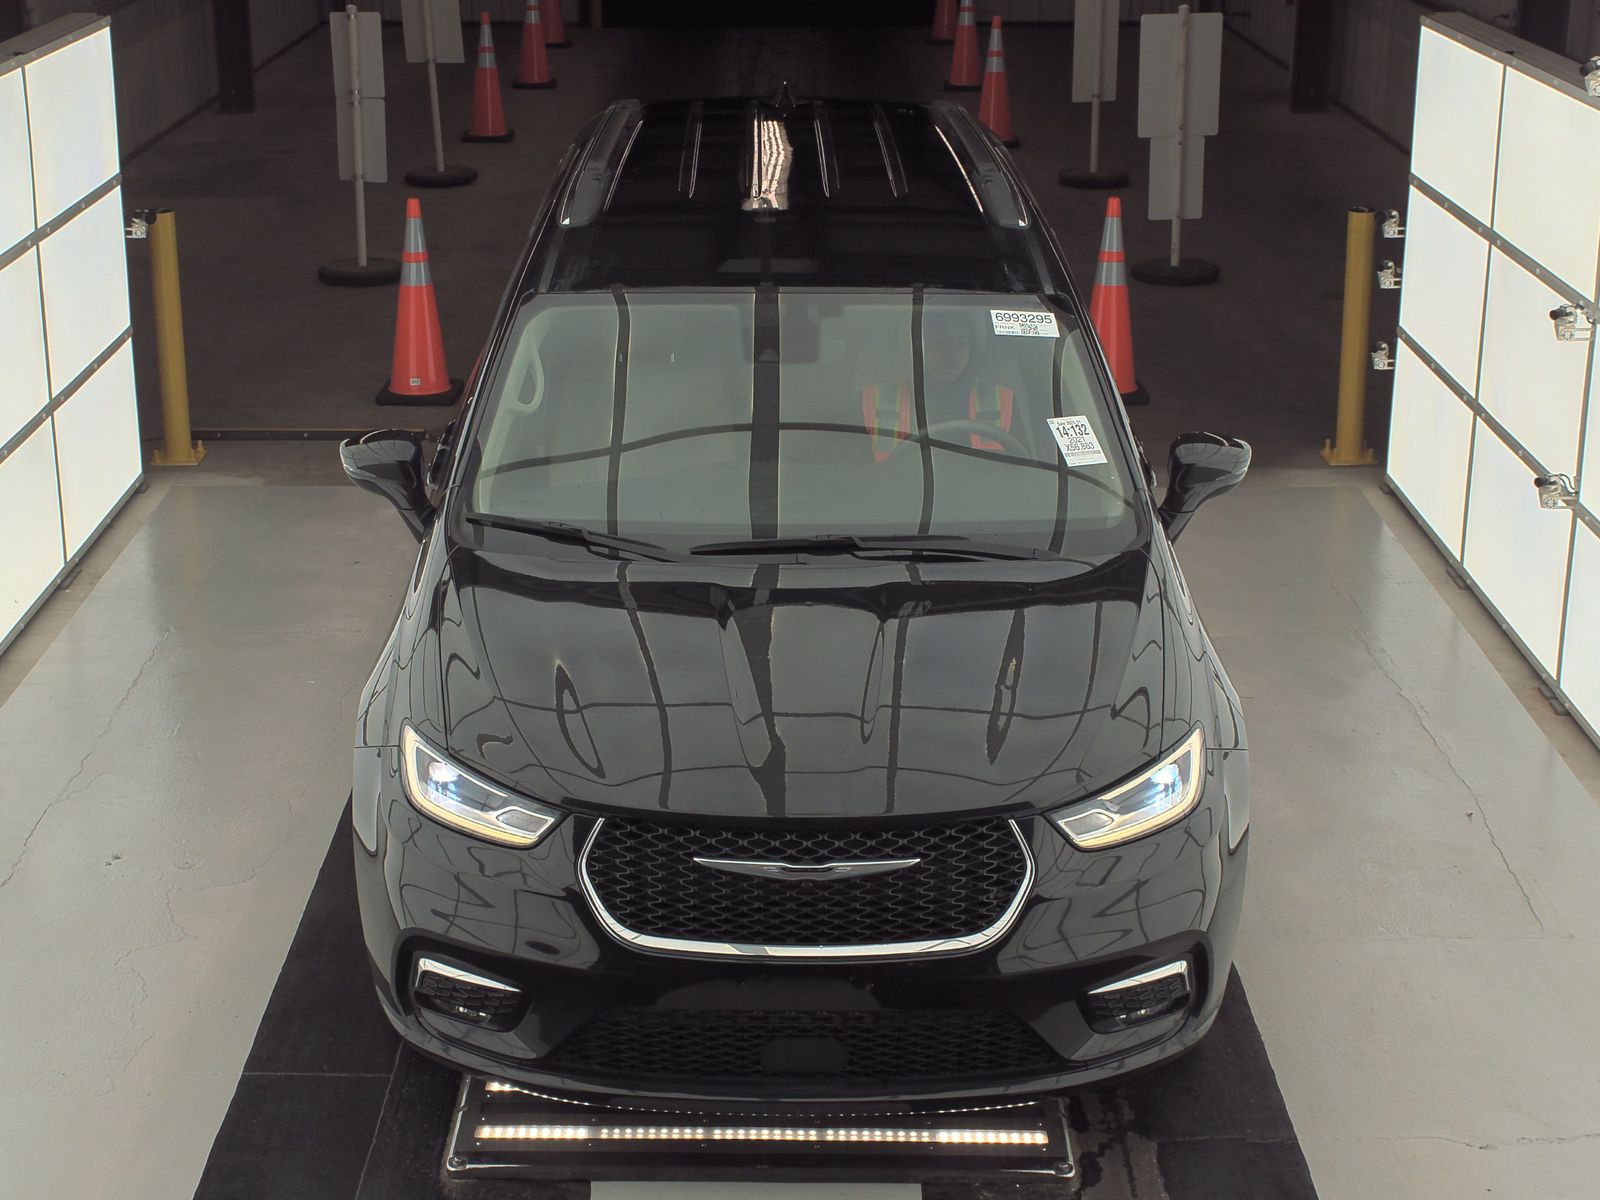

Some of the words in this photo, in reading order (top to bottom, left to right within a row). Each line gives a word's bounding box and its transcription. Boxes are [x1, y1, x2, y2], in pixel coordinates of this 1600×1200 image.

[995, 312, 1053, 324] 6993295
[1056, 424, 1090, 438] 14:132
[1068, 436, 1086, 444] 2021
